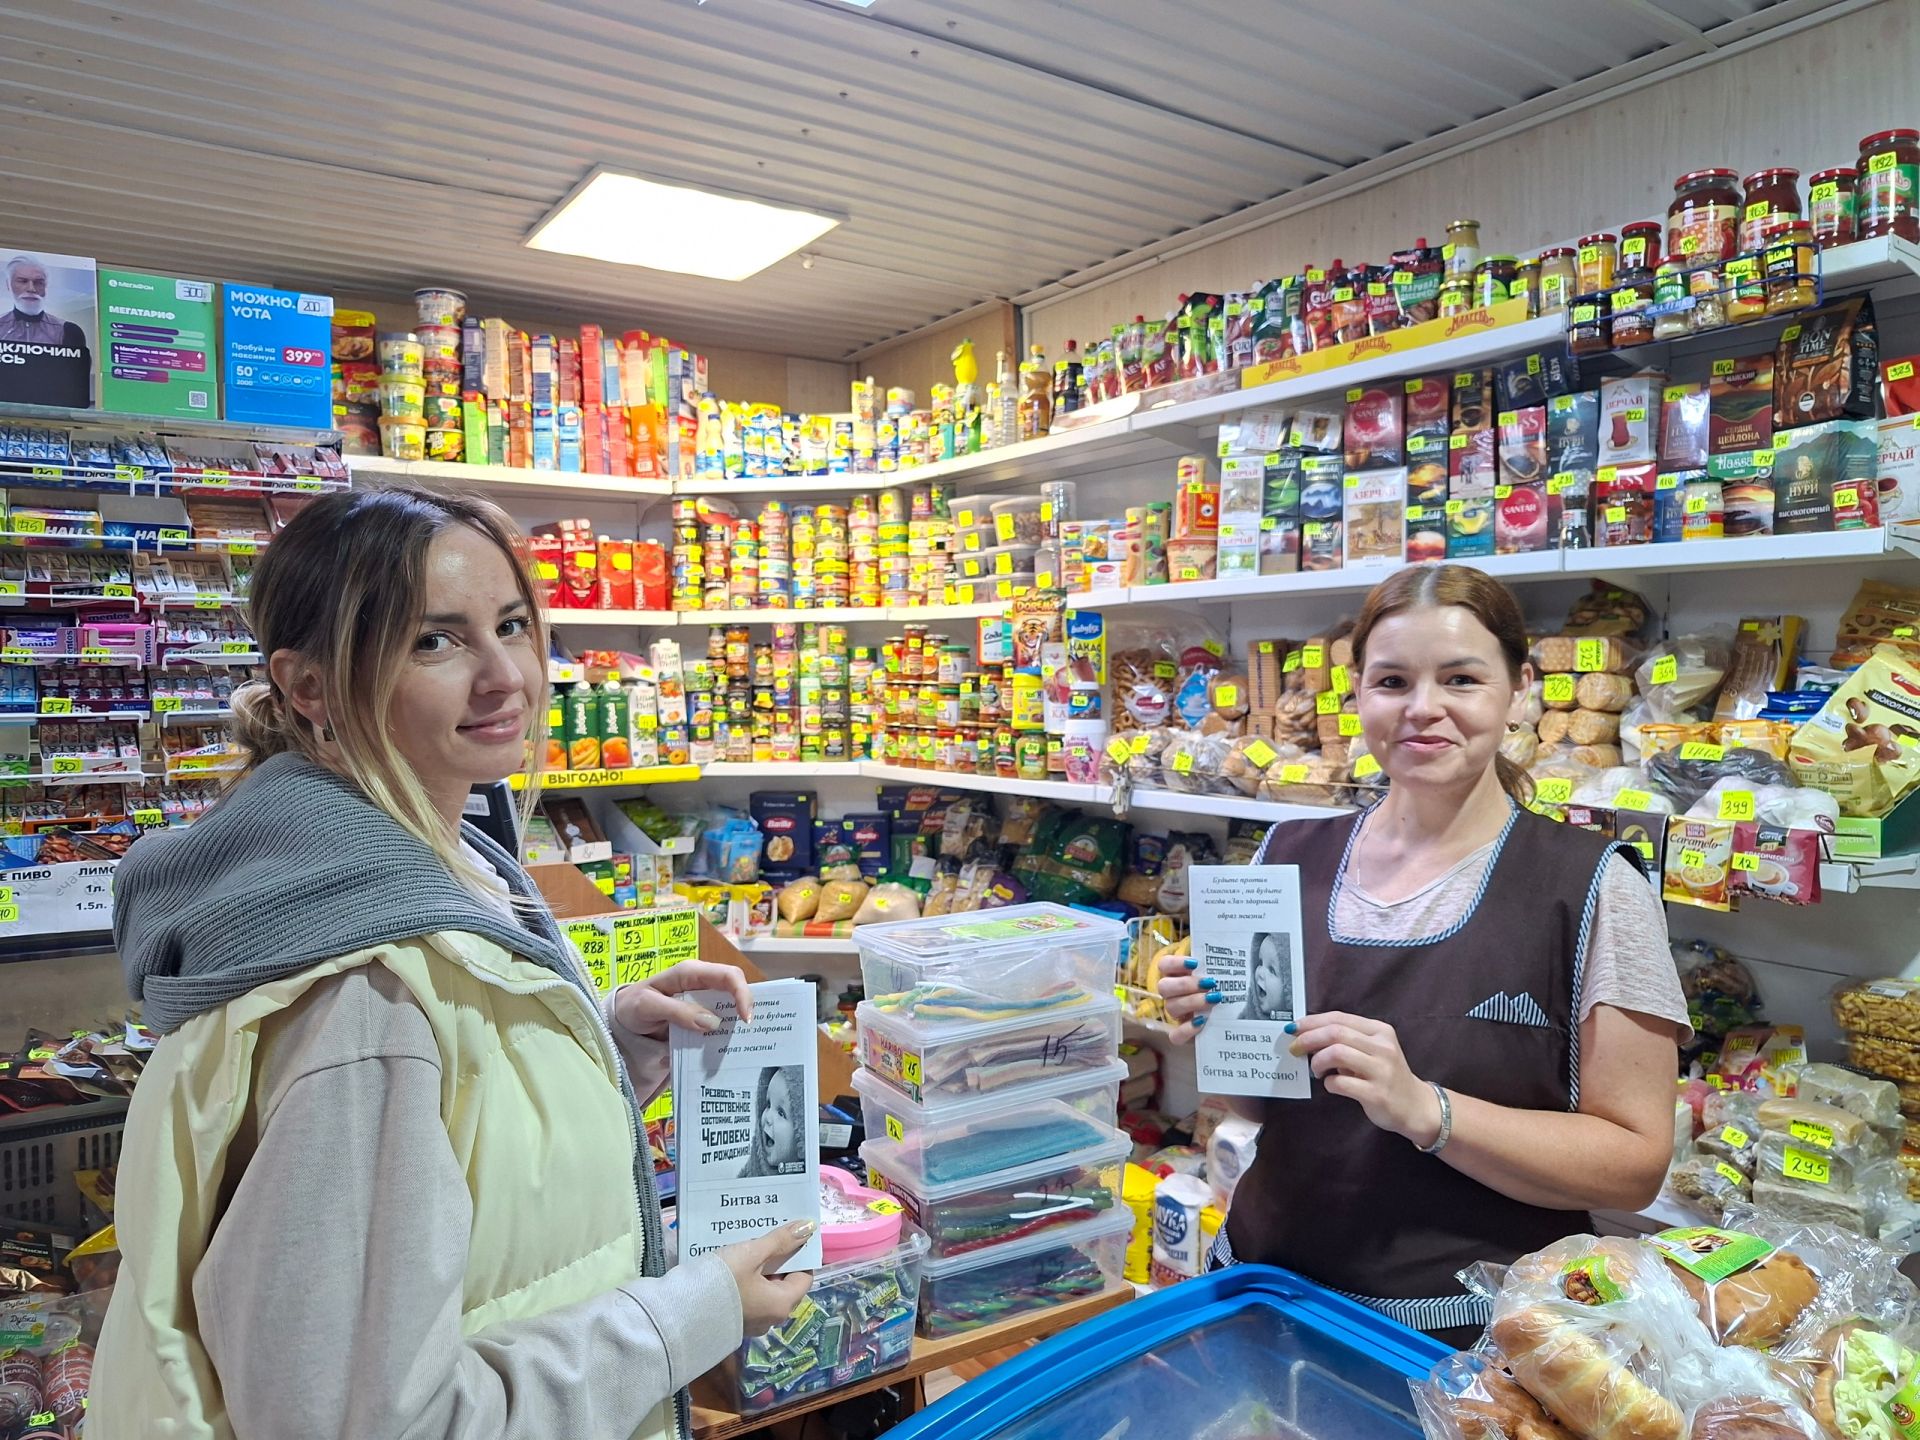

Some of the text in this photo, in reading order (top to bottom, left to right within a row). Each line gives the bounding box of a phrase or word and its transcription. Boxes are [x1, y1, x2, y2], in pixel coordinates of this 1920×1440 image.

[1815, 186, 1832, 200] 82
[230, 291, 296, 309] МОЖНО.
[109, 305, 175, 320] МЕГАТАРИФ
[231, 306, 272, 320] YOTA
[1800, 328, 1832, 345] BON
[231, 342, 261, 354] Пробуй
[1800, 340, 1826, 354] TIME
[231, 352, 276, 362] максимум
[285, 350, 312, 363] 399
[236, 365, 253, 377] 50
[1718, 431, 1761, 446] ЦЕЙЛОНА
[1789, 482, 1819, 498] НУРИ
[1503, 503, 1537, 515] SANTAR
[44, 526, 96, 536] HALLS
[87, 613, 131, 622] mentos
[1071, 623, 1100, 635] babyfox
[1580, 647, 1593, 671] 325
[1547, 681, 1571, 697] 305
[47, 702, 65, 713] 37
[160, 699, 176, 710] 37
[56, 760, 76, 771] 30
[548, 771, 624, 785] ВЫГОДНО!
[1538, 783, 1569, 801] 288
[1722, 800, 1748, 816] 399
[139, 813, 157, 824] 30
[766, 819, 793, 829] Barilla
[1685, 854, 1699, 866] 27
[1738, 857, 1755, 869] 12
[11, 870, 52, 881] ПИВО
[623, 930, 642, 945] 53
[583, 940, 604, 954] 888
[1205, 955, 1247, 968] ЕСТЕСТВЕННОЕ
[621, 960, 654, 983] 127
[1212, 980, 1247, 991] ЕЛОВЕКУ
[752, 1000, 780, 1009] ротив
[766, 1011, 797, 1022] будьте
[703, 1028, 729, 1037] всегда
[753, 1023, 793, 1035] здоровый
[1224, 1030, 1272, 1043] Битва за
[718, 1042, 777, 1055] образ жизни!
[1218, 1050, 1273, 1061] трезвость
[908, 1061, 918, 1076] 15
[1202, 1065, 1299, 1081] битва за Россию!
[700, 1101, 751, 1113] ЕСТЕСТВЕННОЕ
[701, 1152, 712, 1164] ОТ
[1792, 1157, 1826, 1177] 295
[720, 1193, 779, 1207] Битва за
[710, 1216, 779, 1234] трезвость
[9, 1313, 38, 1327] Дубки
